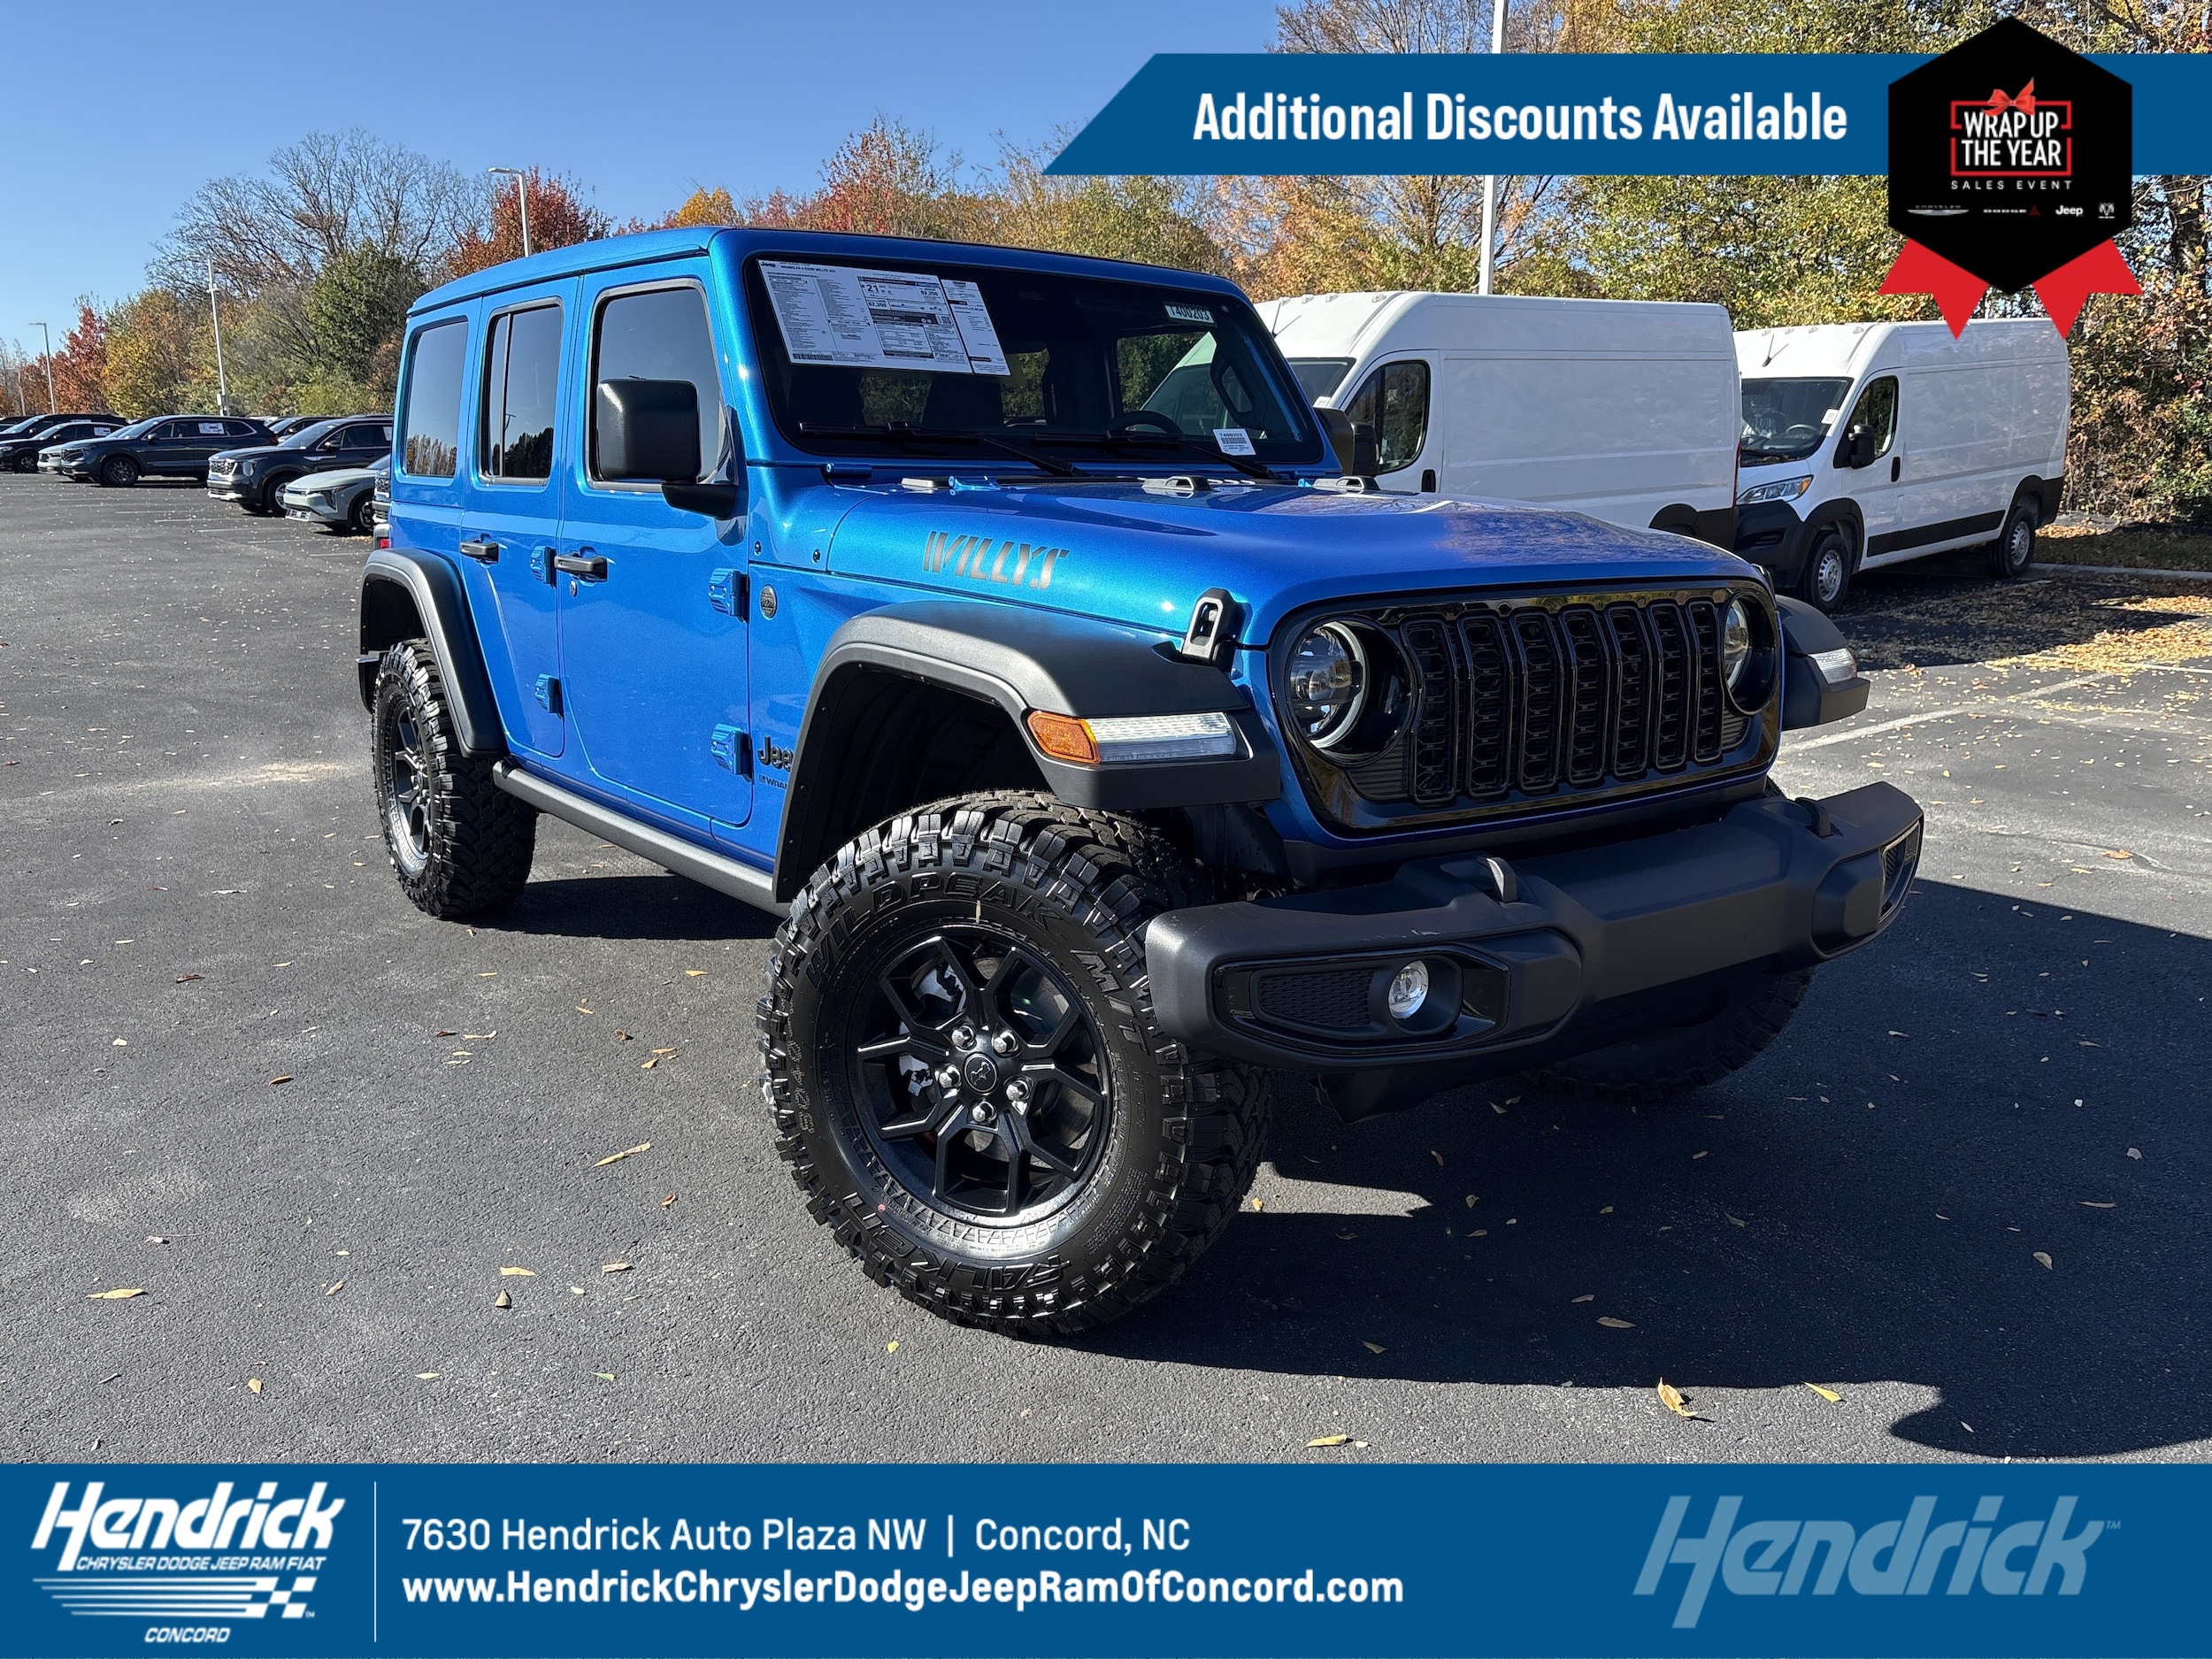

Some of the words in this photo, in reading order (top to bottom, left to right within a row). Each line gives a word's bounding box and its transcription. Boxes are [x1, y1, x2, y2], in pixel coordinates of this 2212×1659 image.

[867, 284, 879, 293] 21
[923, 530, 1071, 591] WILLYS
[757, 735, 795, 773] Jee
[806, 872, 1064, 992] WILDPEAK
[841, 1192, 1071, 1291] FALKEN
